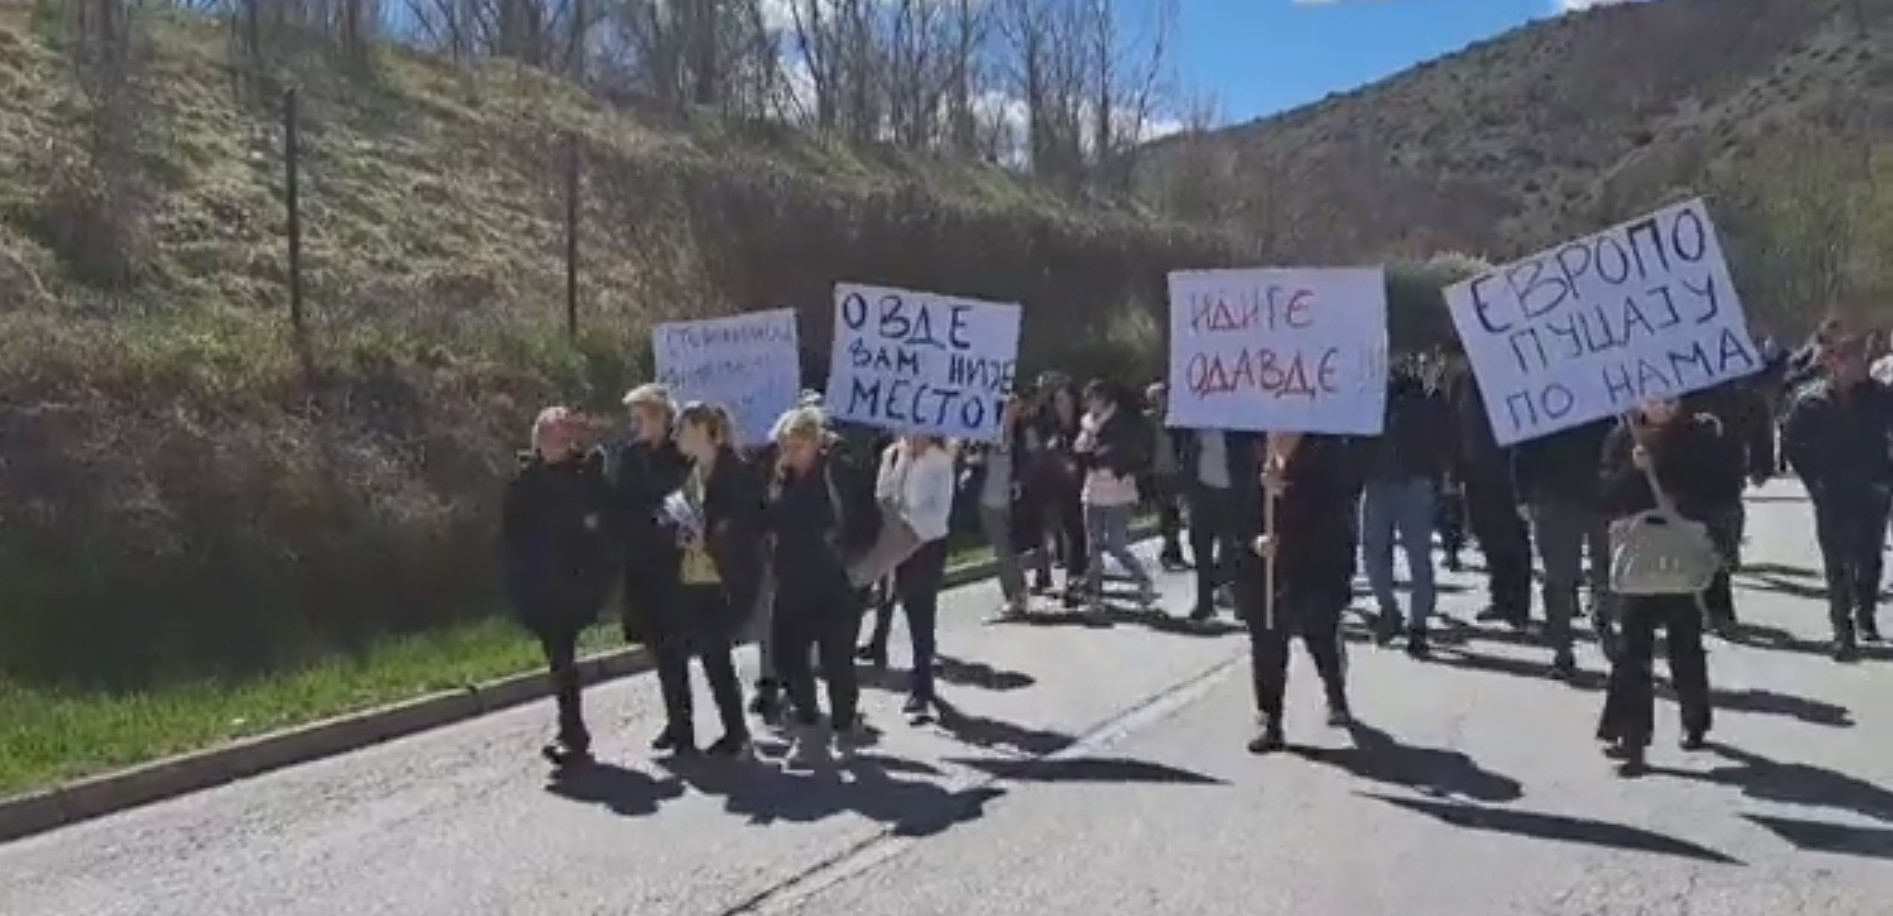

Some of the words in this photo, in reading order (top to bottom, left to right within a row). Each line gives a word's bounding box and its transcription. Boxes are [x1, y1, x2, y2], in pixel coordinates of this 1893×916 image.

[1469, 206, 1706, 335] ЕВРОПО
[843, 292, 974, 350] ОВДЕ
[847, 336, 920, 376] ВАМ
[1186, 344, 1341, 402] ОДАВДЕ
[1506, 381, 1574, 433] ПО
[1602, 326, 1755, 405] НАМА
